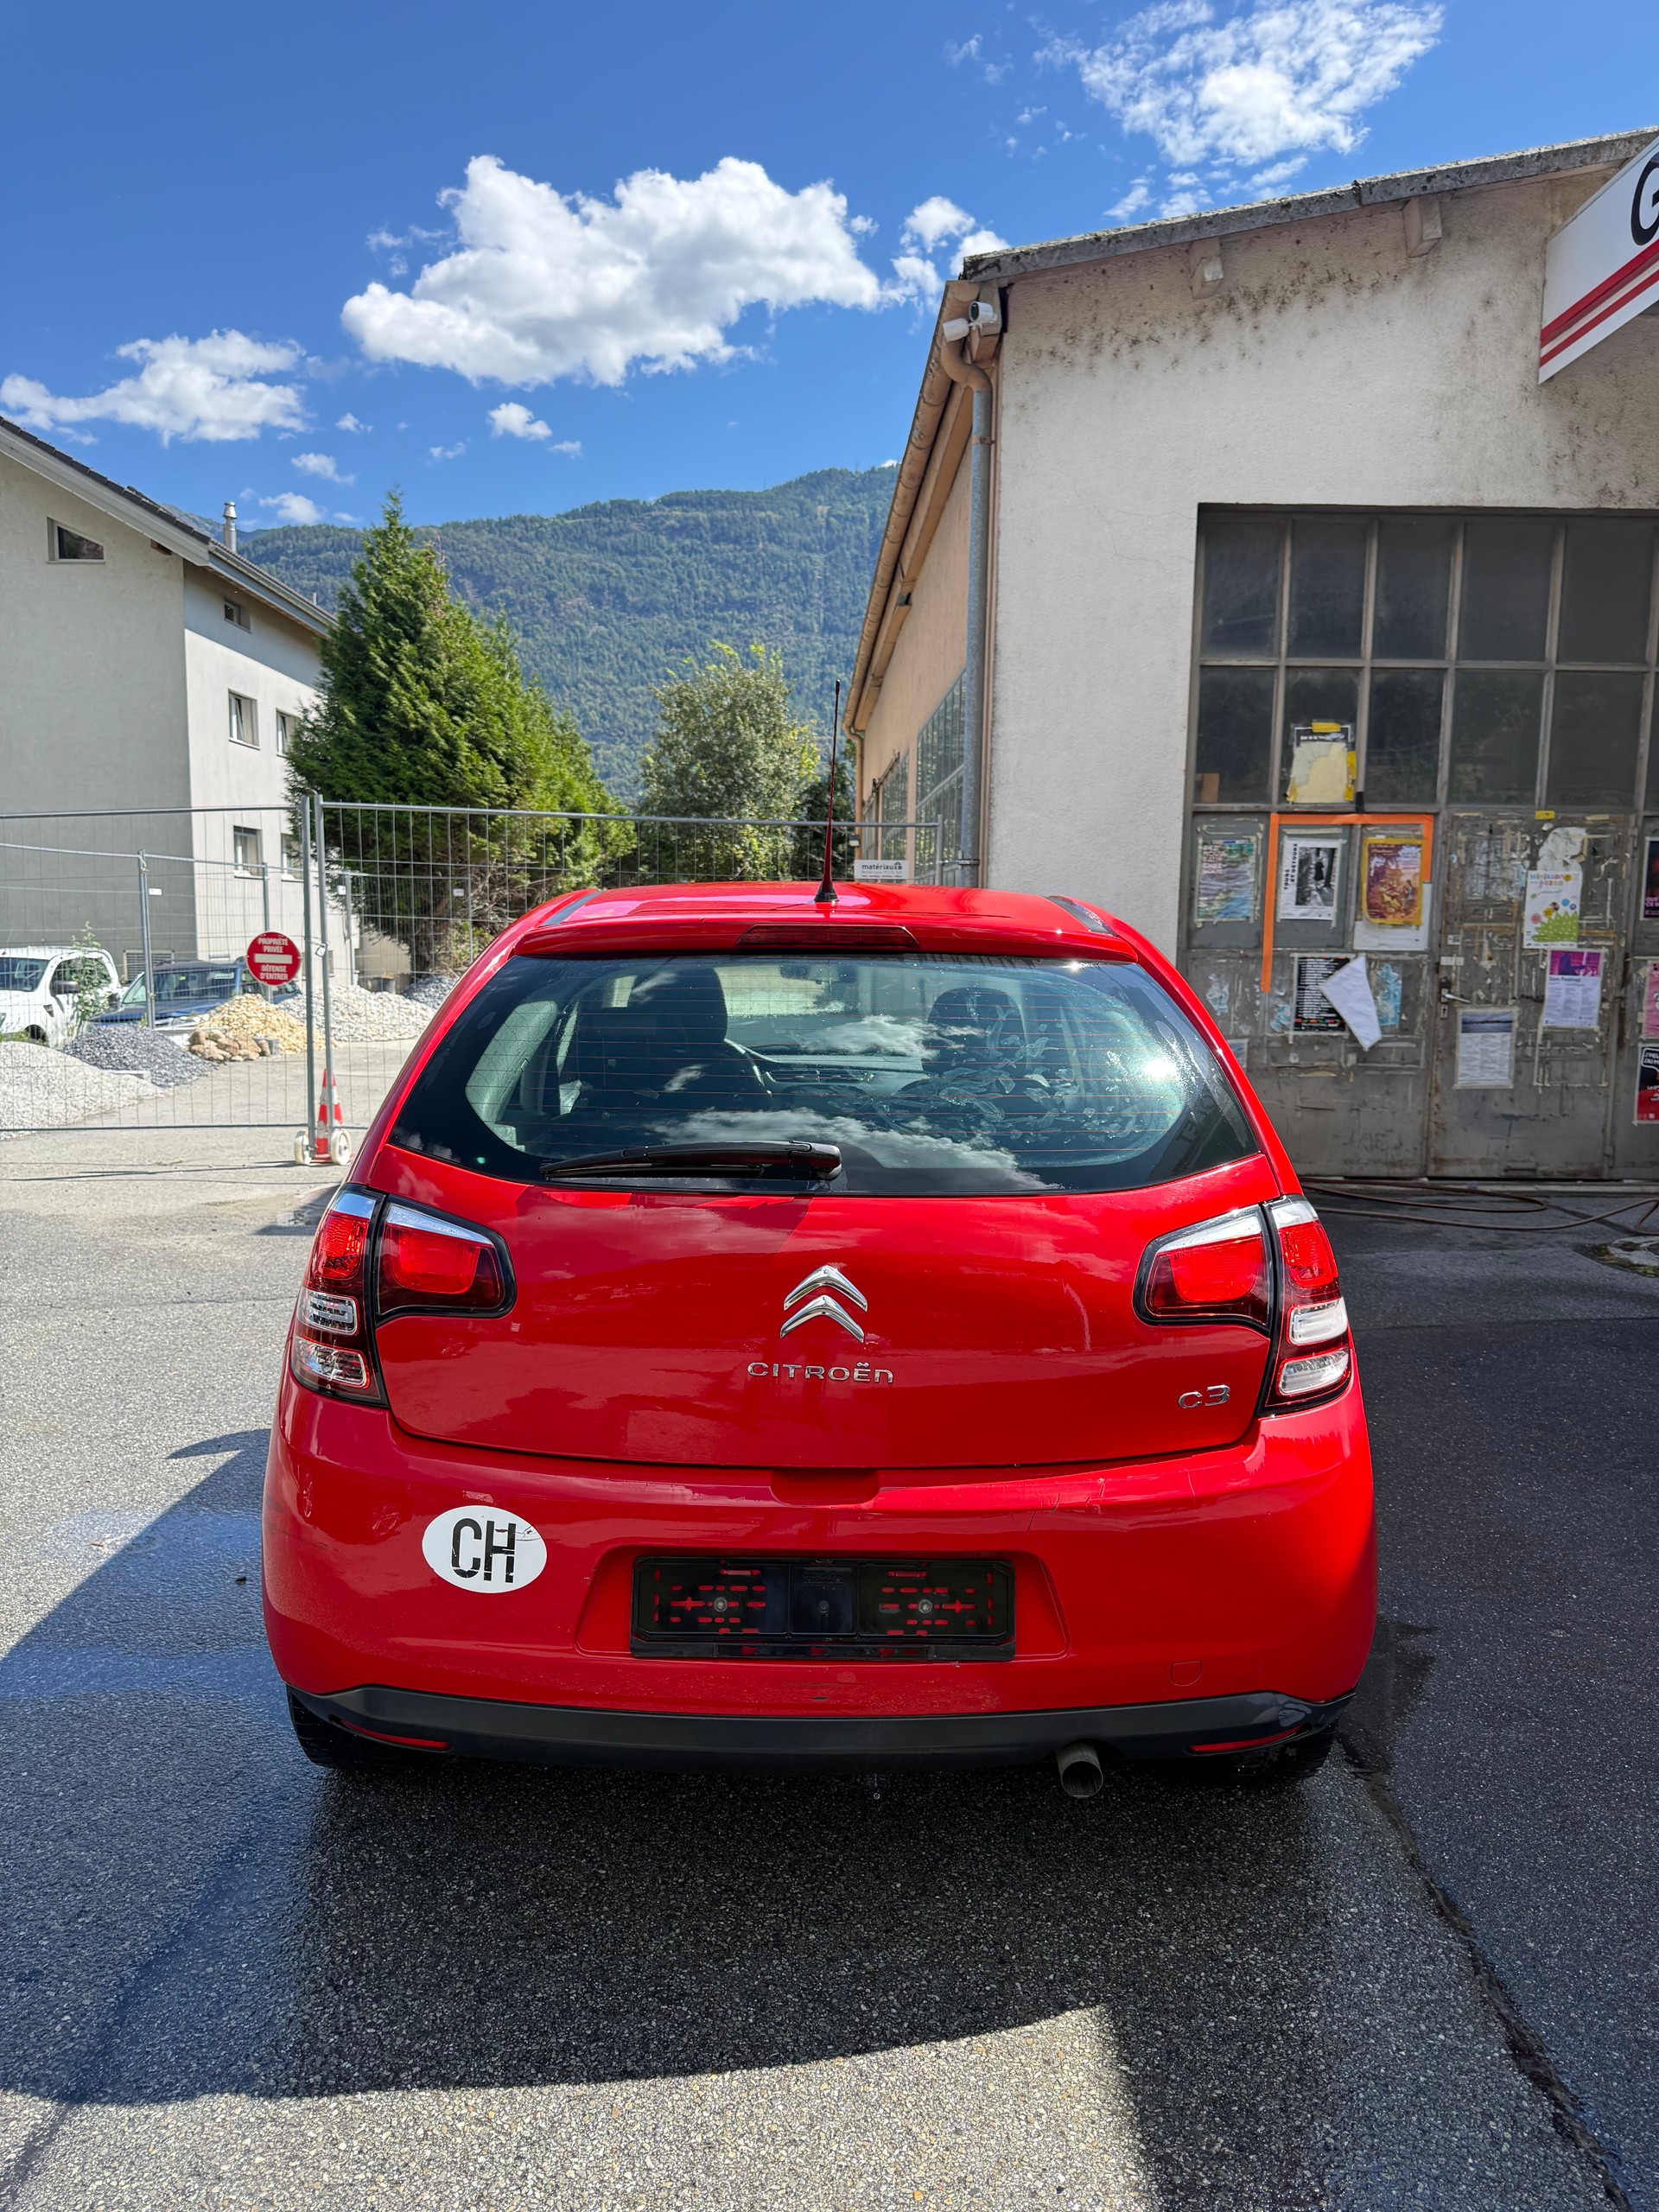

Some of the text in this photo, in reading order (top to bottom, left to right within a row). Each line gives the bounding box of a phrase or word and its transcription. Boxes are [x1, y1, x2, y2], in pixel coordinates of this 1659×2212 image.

[747, 1362, 893, 1383] CITROËN
[1178, 1384, 1230, 1409] C3
[451, 1517, 517, 1584] CH
